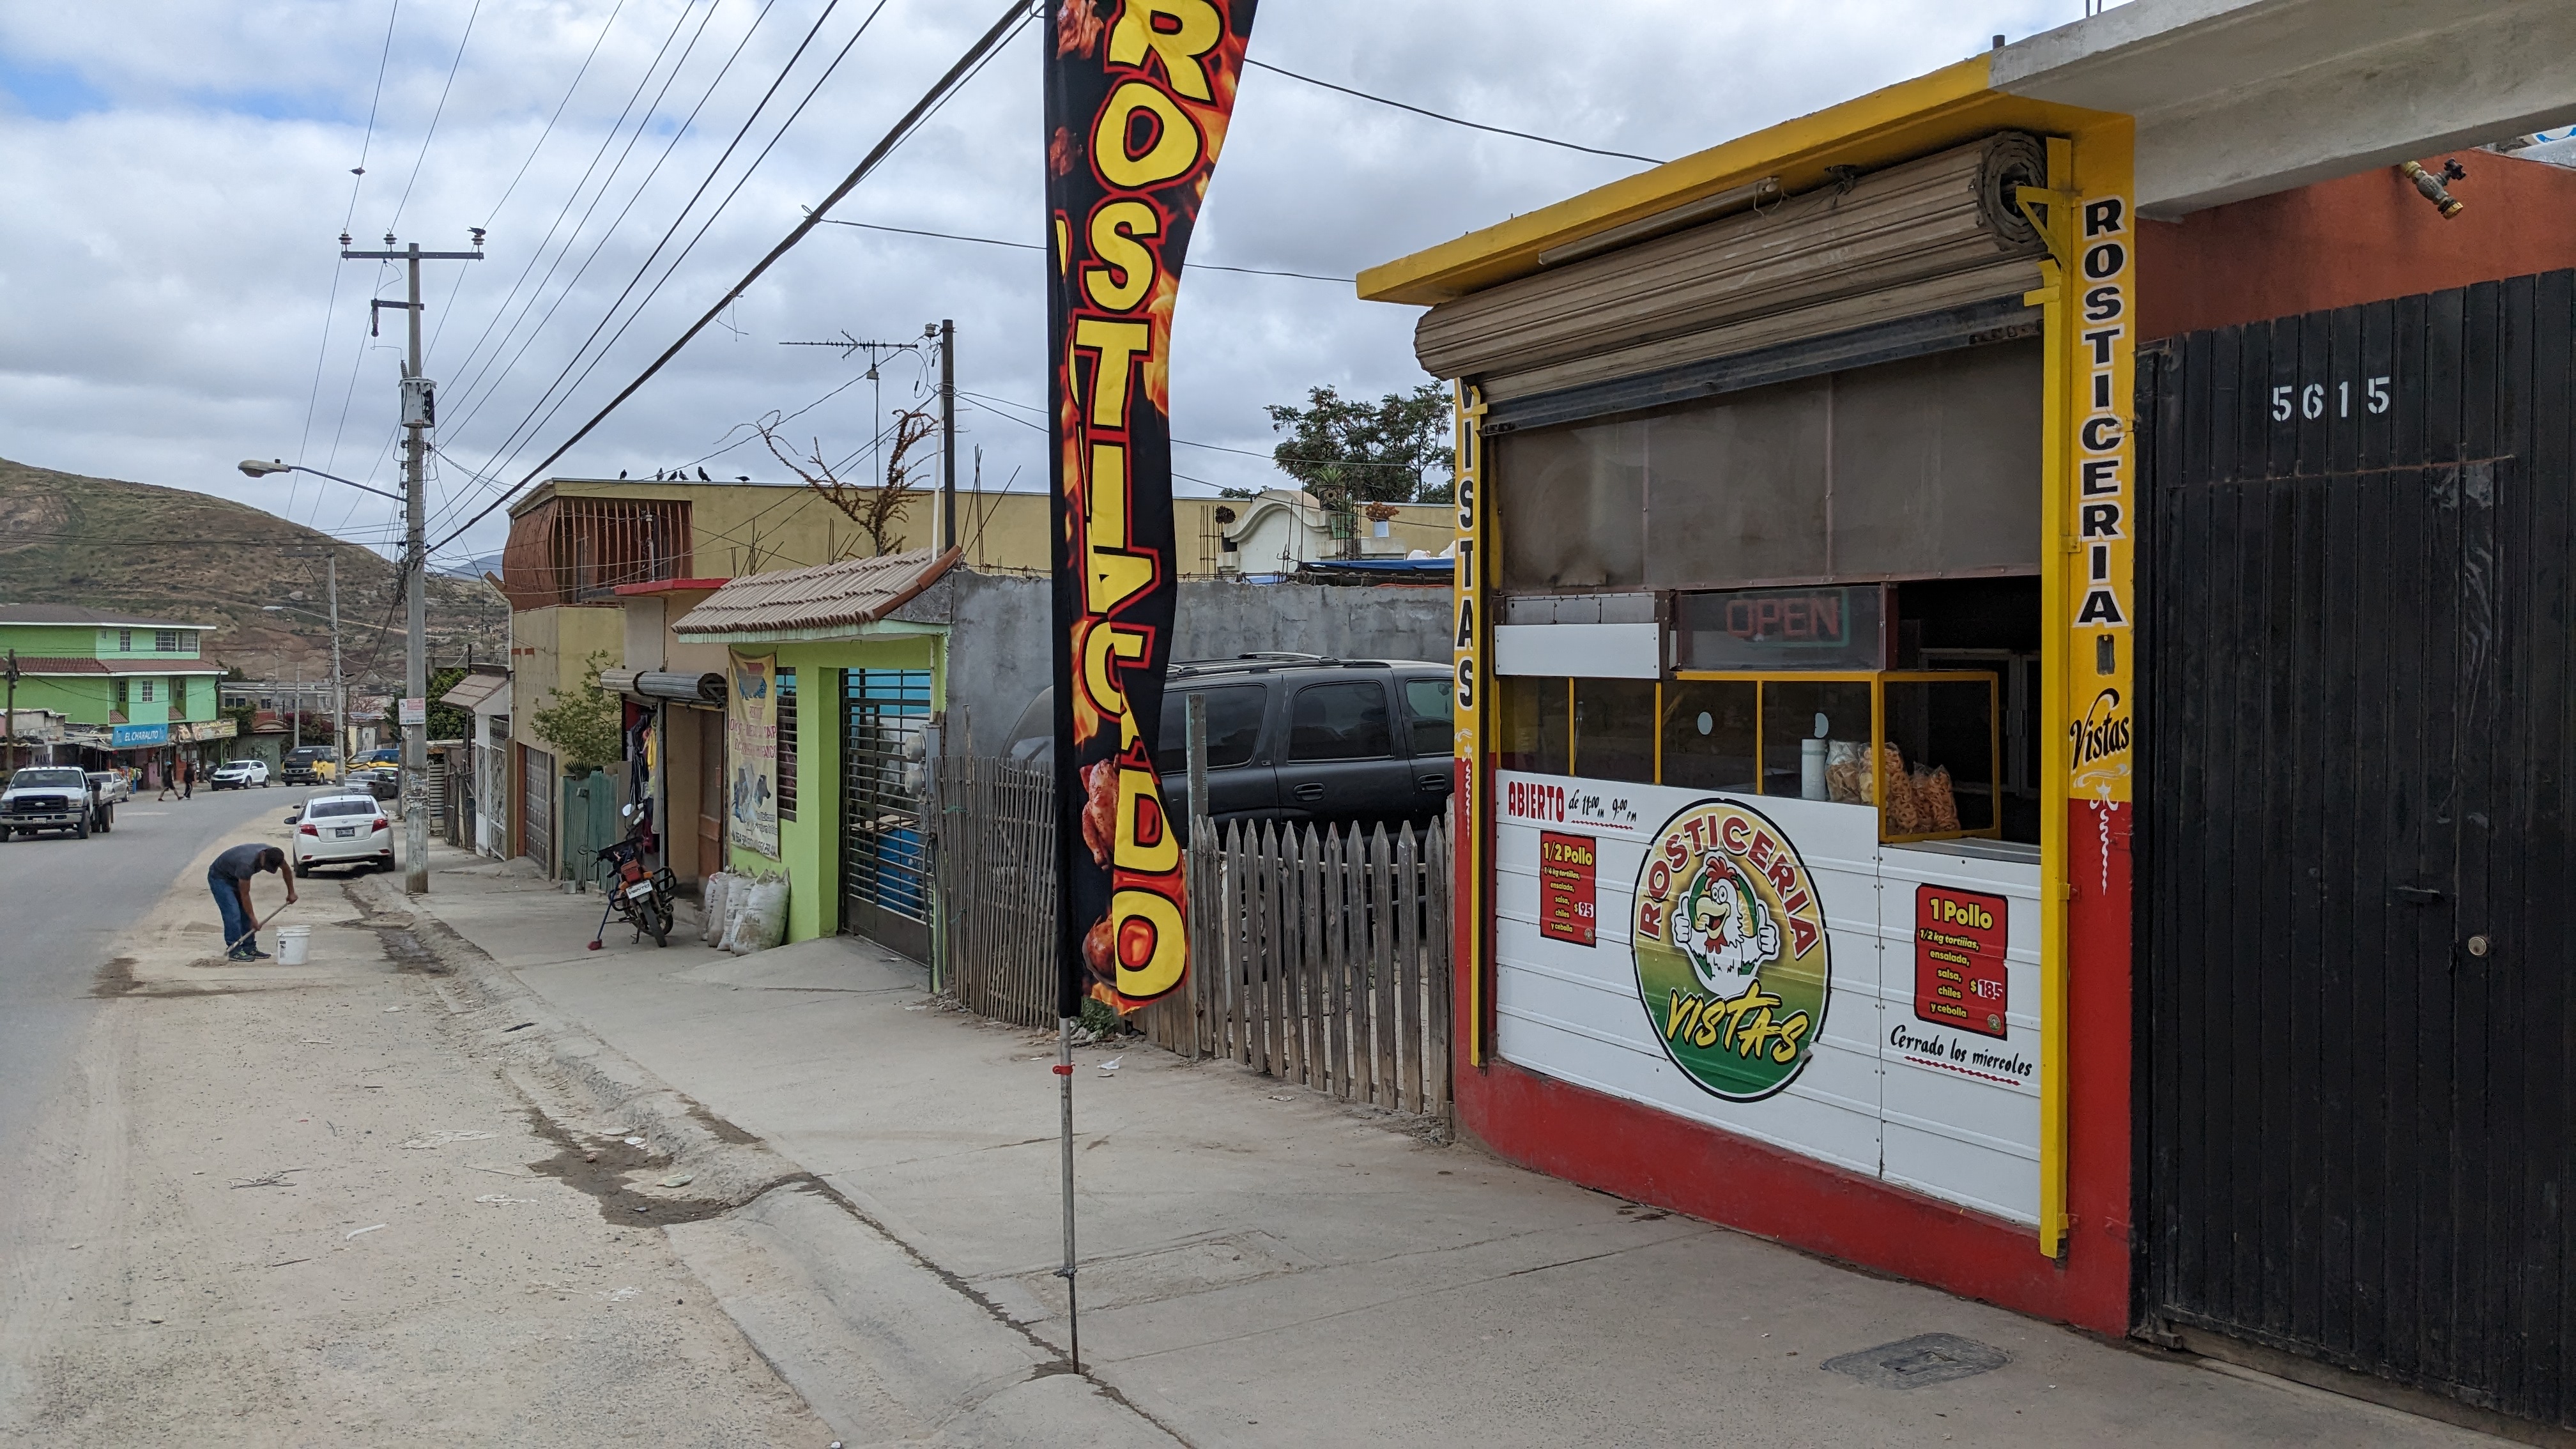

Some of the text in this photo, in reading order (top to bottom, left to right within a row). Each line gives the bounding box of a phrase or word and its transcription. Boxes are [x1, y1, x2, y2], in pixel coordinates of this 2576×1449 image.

[2076, 197, 2128, 627] ROSTICERIA
[2272, 376, 2391, 422] 5615
[1455, 378, 1474, 711] VISTAS
[1726, 595, 1839, 638] OPEN
[125, 732, 131, 742] EL
[2069, 687, 2129, 771] Vistas
[1508, 781, 1565, 823] ABIERTO
[1568, 789, 1579, 809] de
[1582, 795, 1600, 816] 11:00
[1612, 798, 1628, 821] 9:00
[1627, 811, 1637, 822] PM
[1543, 840, 1593, 866] 1/2 Pollo
[1544, 866, 1552, 875] 1/4
[1552, 868, 1559, 878] kg
[1554, 895, 1570, 906] salsa,
[1639, 813, 1820, 962] ROSTICERIA
[1555, 908, 1570, 918] chiles
[1930, 898, 1993, 930] 1 Pollo
[1554, 924, 1573, 933] cebolla
[1920, 929, 1979, 951] 1/2 kg tortillas,
[1929, 950, 1970, 967] ensalada,
[1937, 969, 1961, 983] salsa,
[1938, 986, 1961, 999] chiles
[1665, 978, 1810, 1064] VISTAS
[1931, 1002, 1967, 1018] y cebolla
[1890, 1024, 2032, 1077] Cerrado los miercoles
